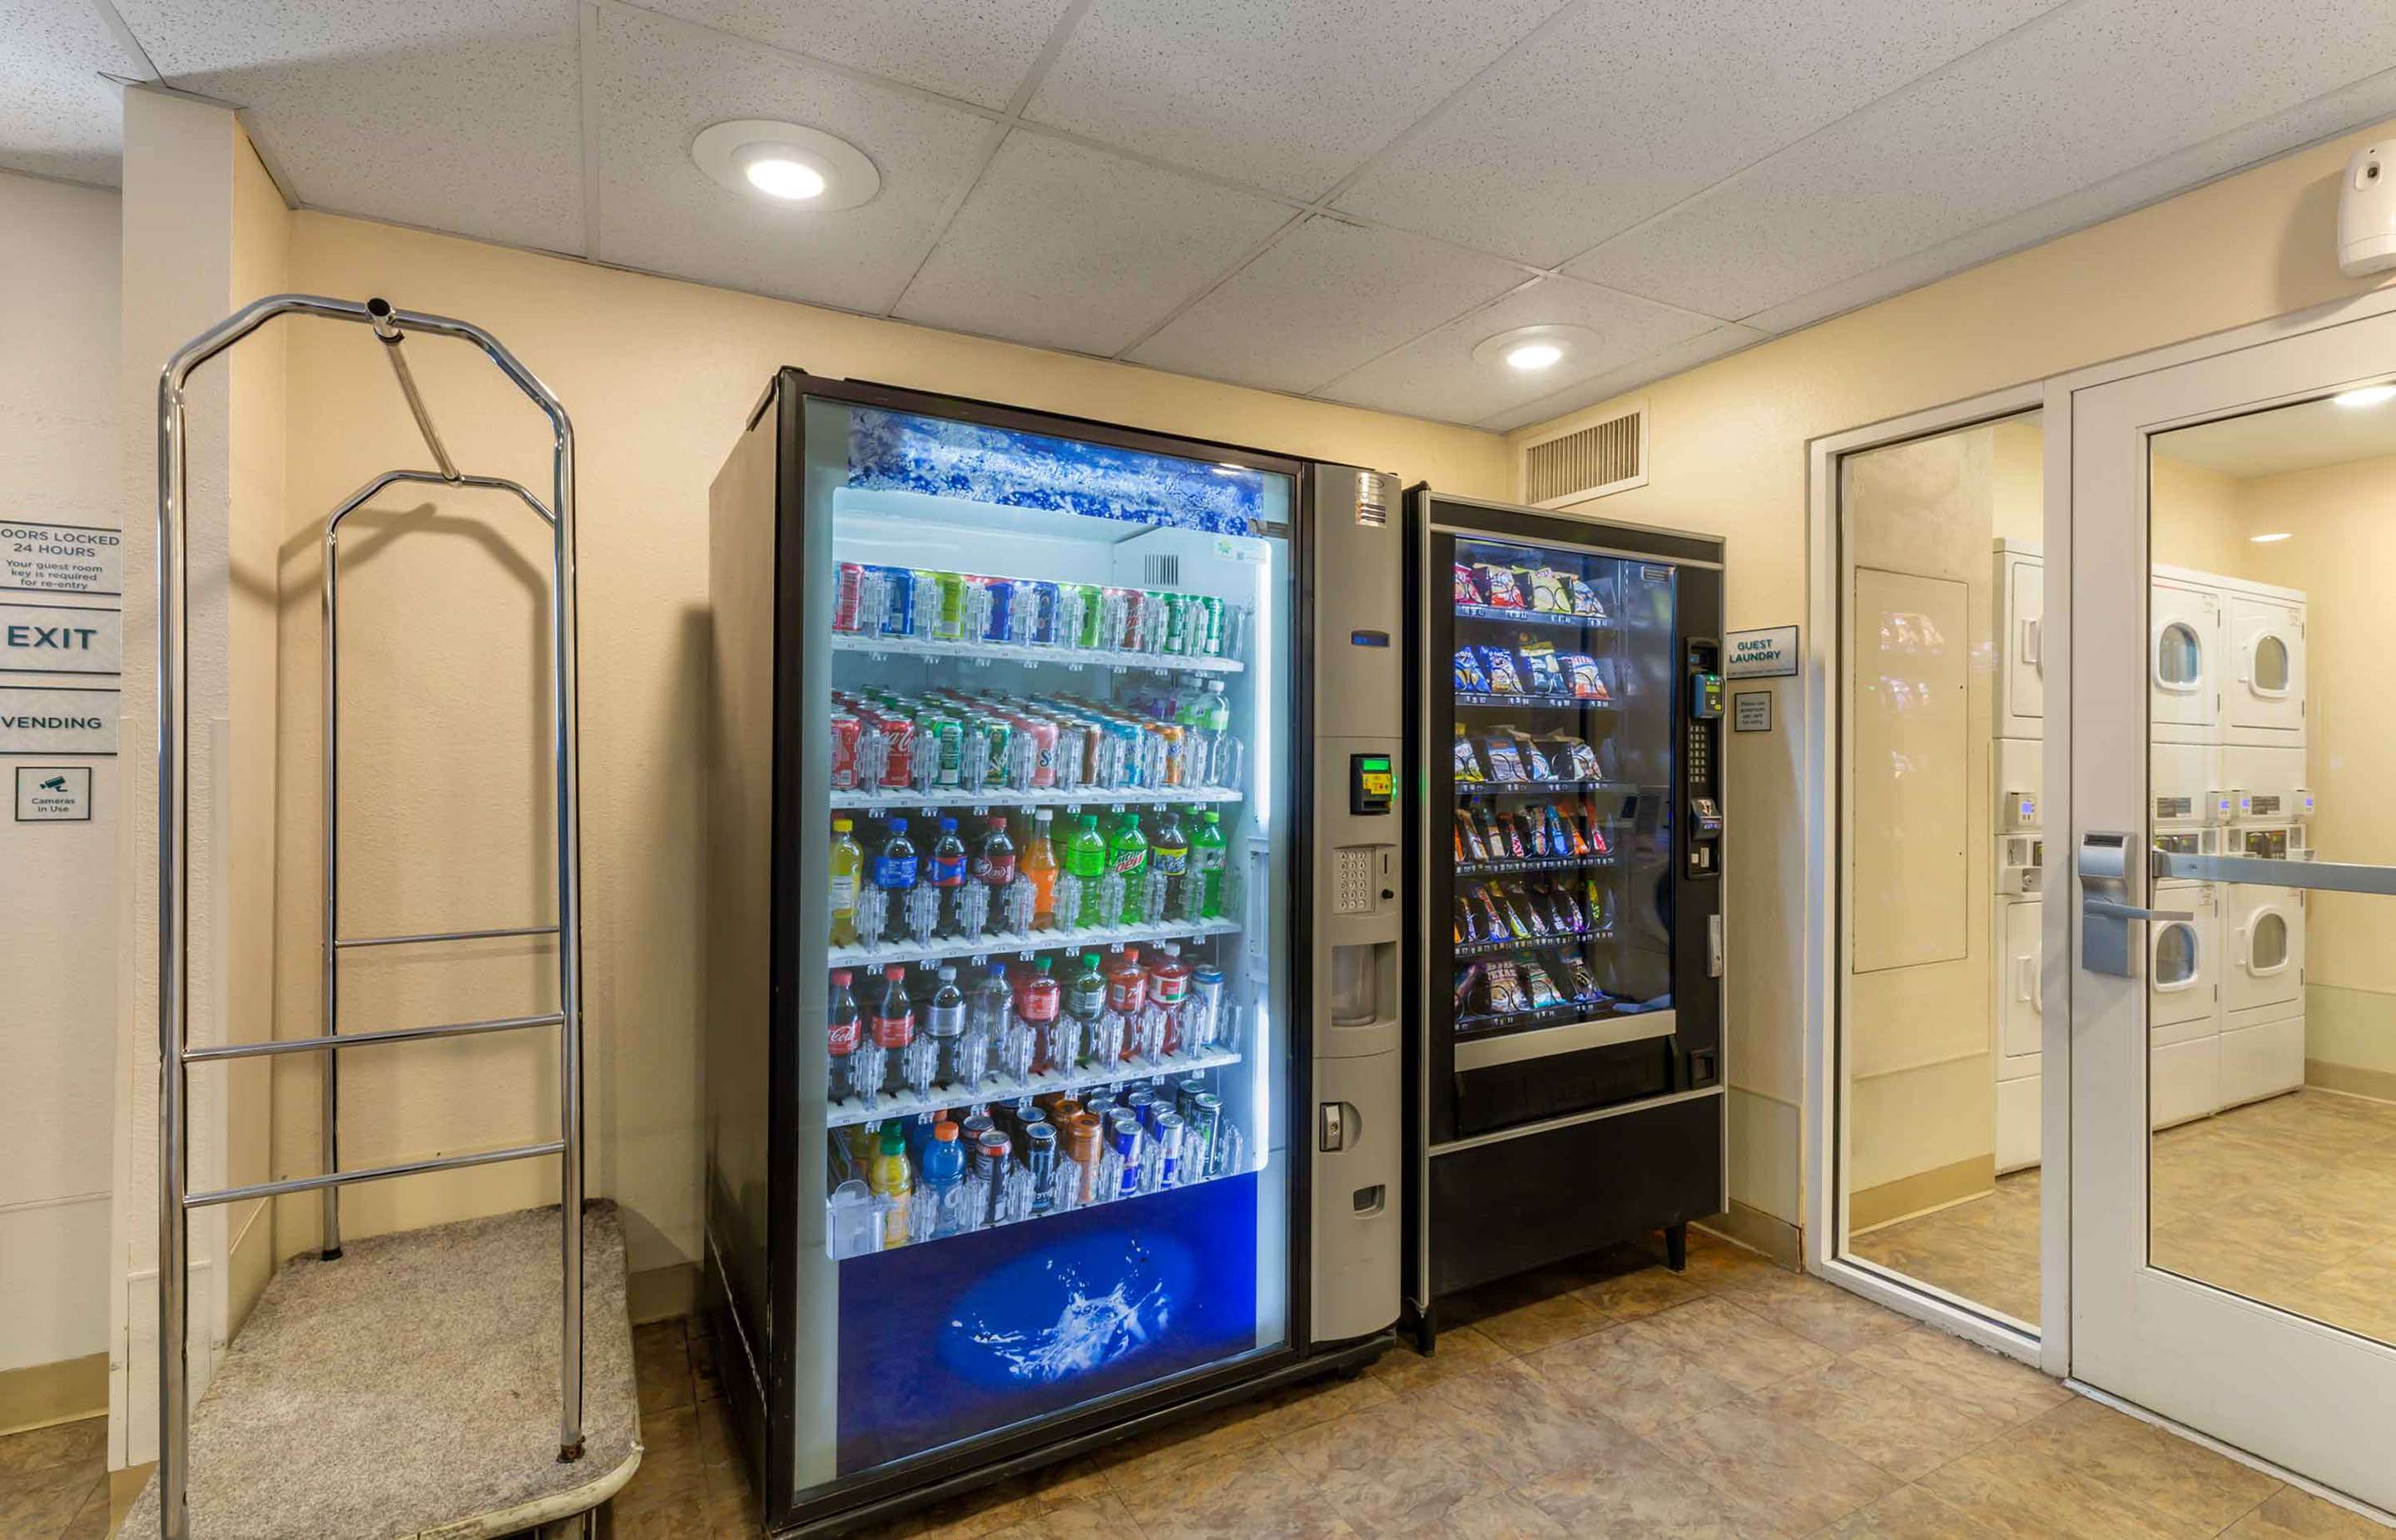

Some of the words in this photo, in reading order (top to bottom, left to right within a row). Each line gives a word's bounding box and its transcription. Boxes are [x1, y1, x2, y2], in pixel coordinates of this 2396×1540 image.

[54, 532, 120, 546] LOCKED
[13, 542, 32, 552] 24
[38, 545, 96, 557] HOURS
[6, 559, 32, 567] Your
[36, 562, 69, 571] guest
[11, 569, 31, 578] key
[48, 572, 97, 582] required
[41, 581, 87, 590] re-entry
[7, 625, 97, 650] EXIT
[1737, 639, 1773, 651] GUEST
[1729, 651, 1781, 663] LAUNDRY
[1, 716, 102, 729] VENDING
